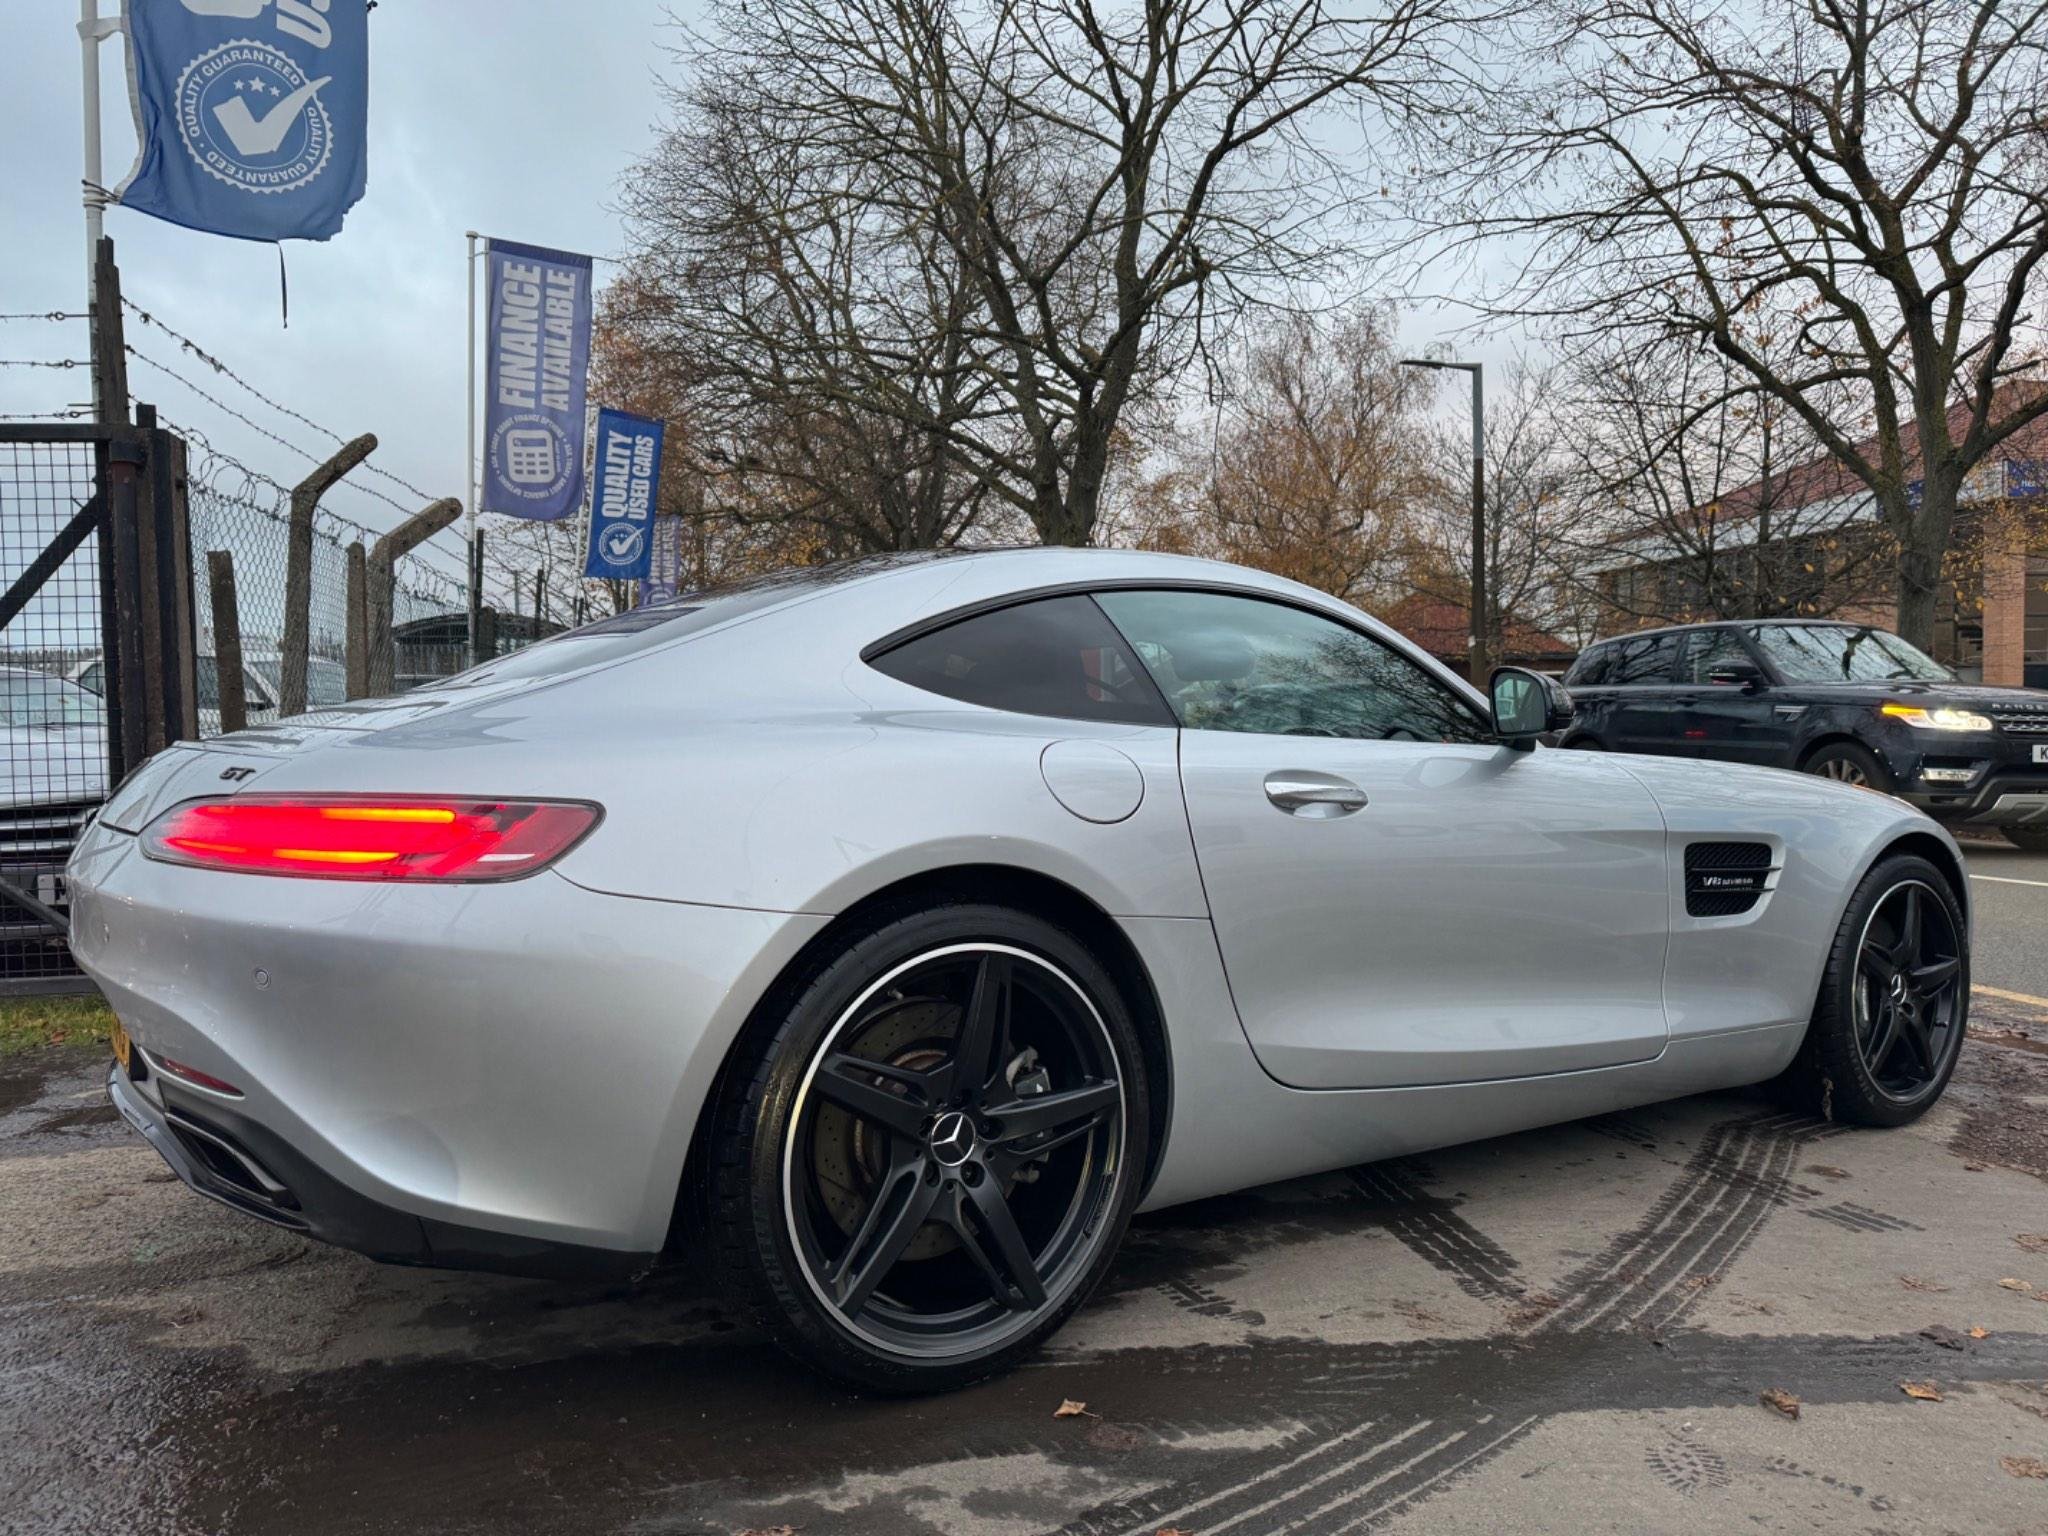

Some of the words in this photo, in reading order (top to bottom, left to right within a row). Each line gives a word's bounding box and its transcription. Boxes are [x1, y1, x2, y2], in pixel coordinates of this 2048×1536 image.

[185, 74, 204, 137] QUALITY
[202, 50, 300, 86] GUARANTEED
[305, 107, 323, 165] QUALITY
[206, 151, 307, 185] GUARANTEED
[499, 261, 541, 408] FINANCE
[542, 269, 576, 412] AVAILABLE
[602, 430, 633, 518] QUALITY
[632, 435, 655, 478] CARS
[628, 480, 649, 520] USED
[219, 767, 256, 781] GT
